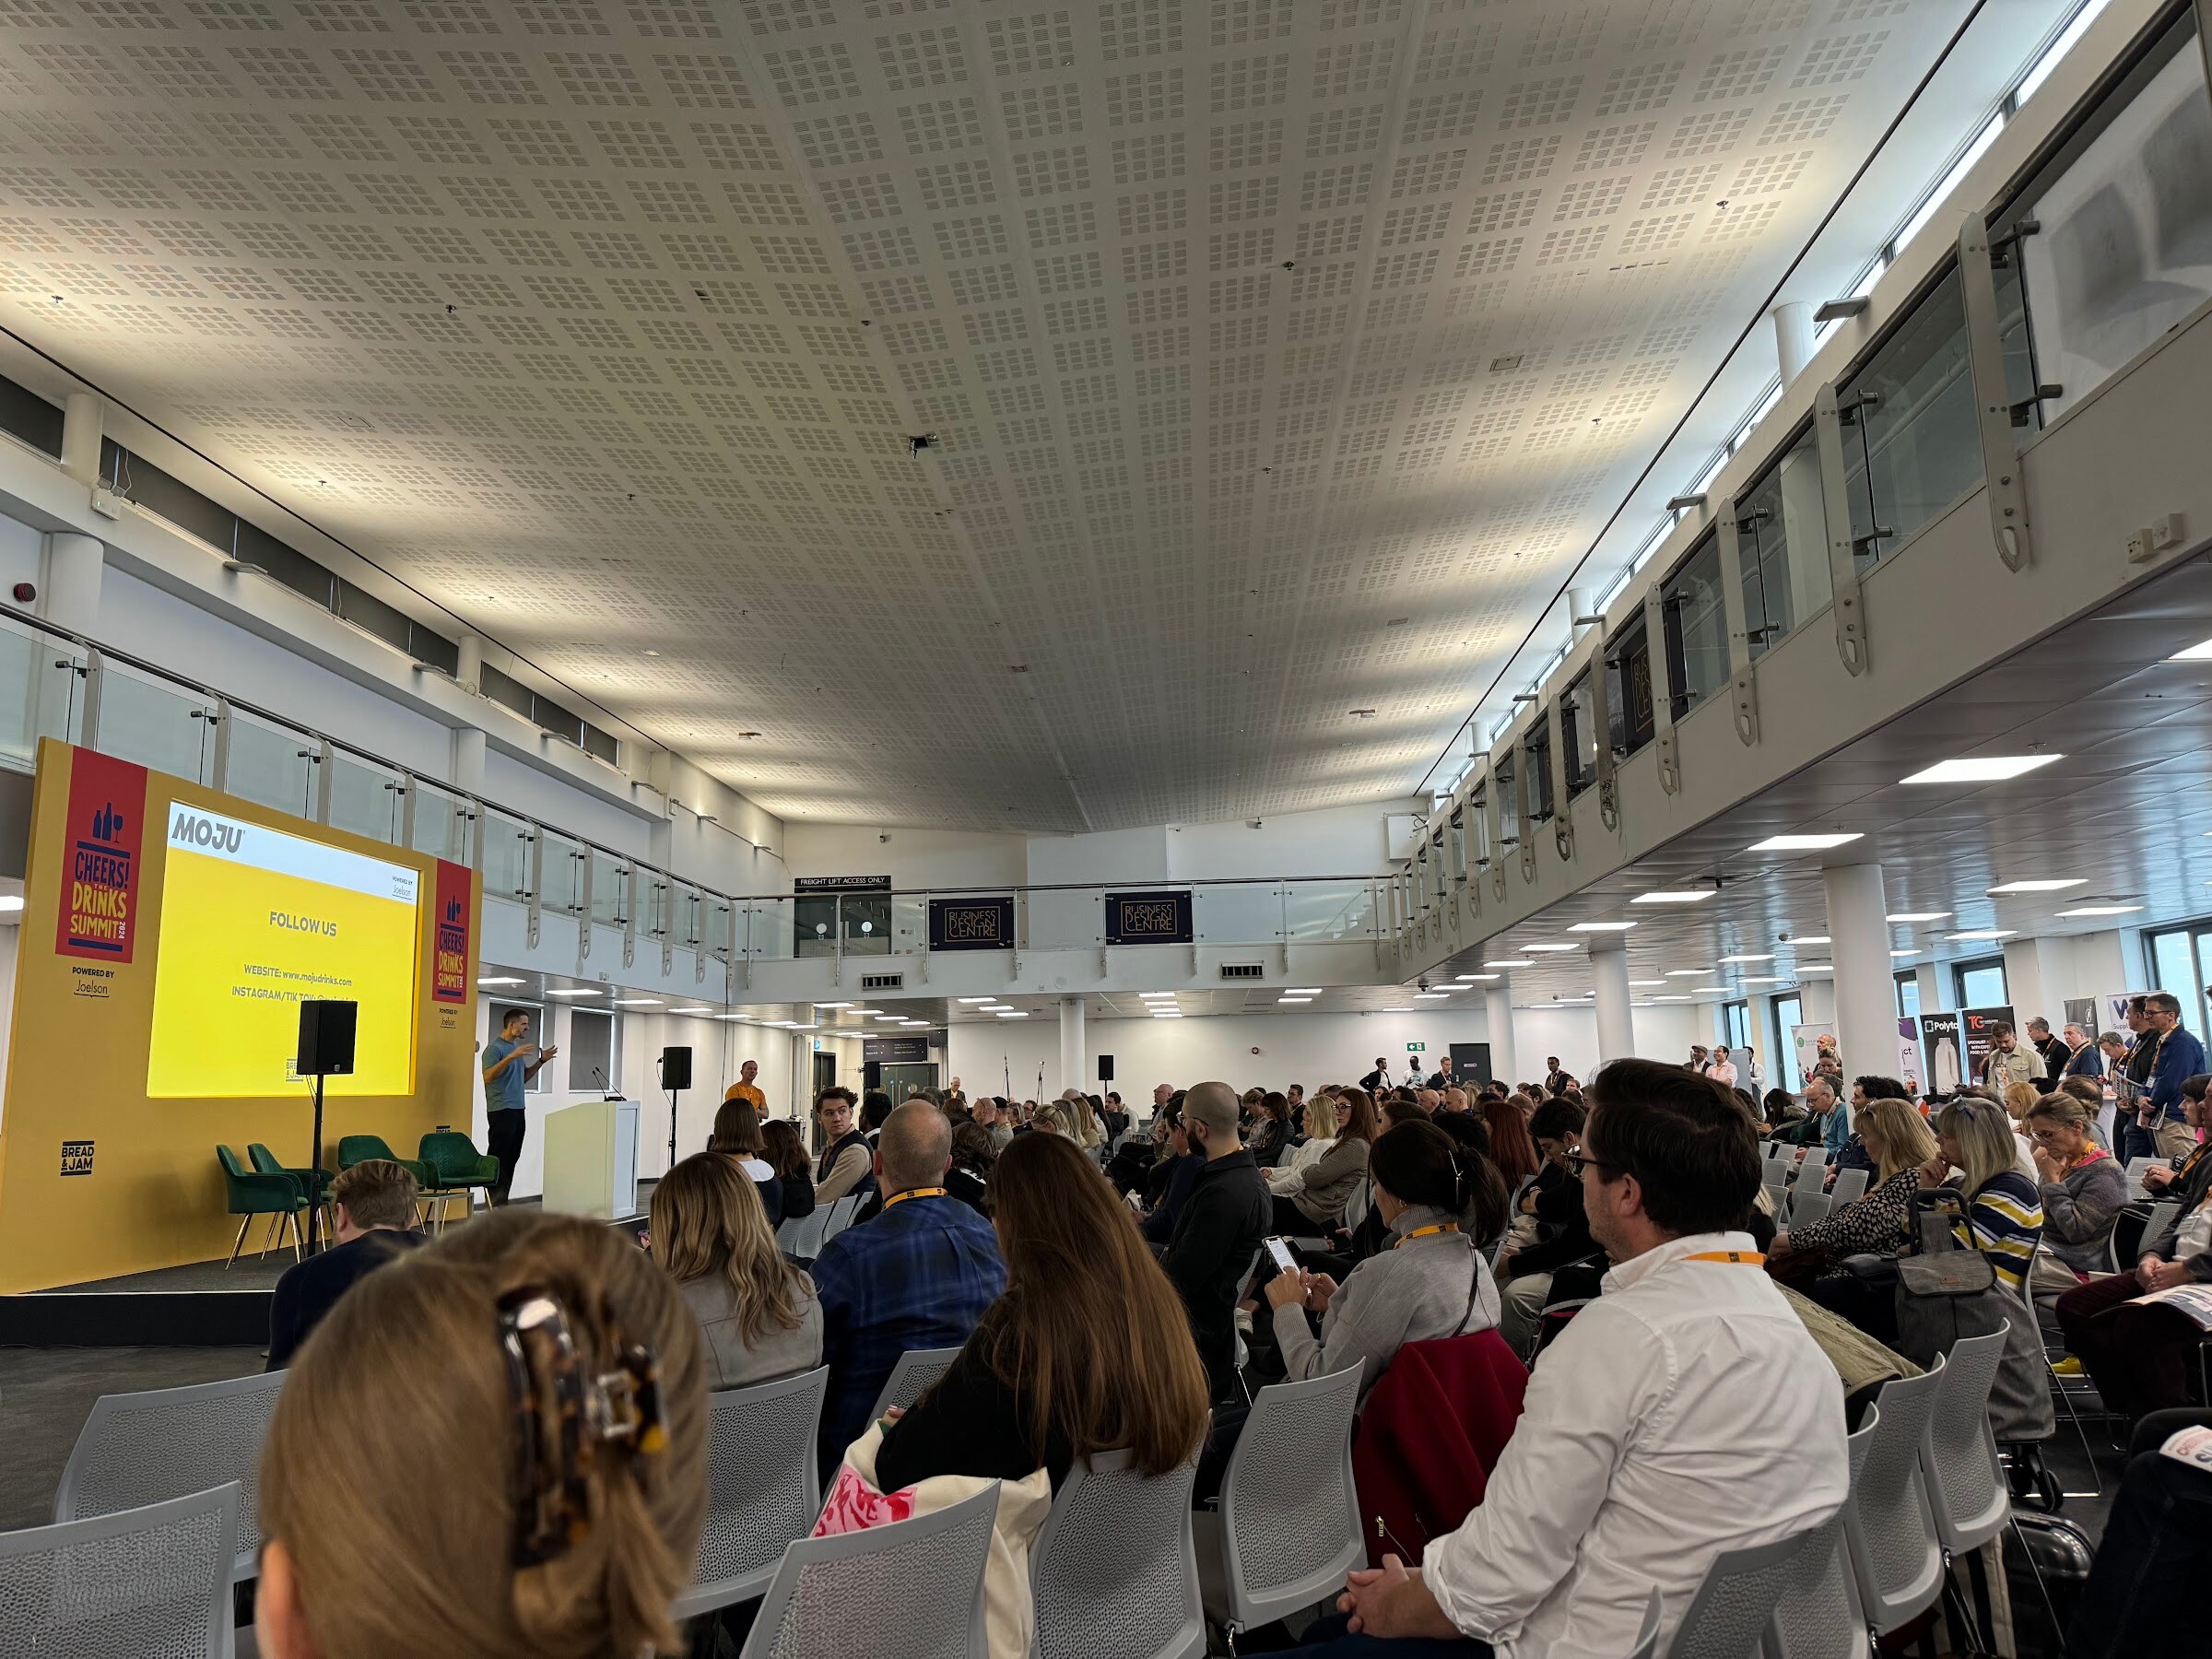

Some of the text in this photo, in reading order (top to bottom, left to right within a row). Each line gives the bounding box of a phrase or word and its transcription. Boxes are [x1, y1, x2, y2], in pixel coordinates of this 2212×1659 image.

[171, 813, 242, 853] MOJU
[75, 852, 130, 889] CHEERS!
[94, 883, 108, 891] THE
[72, 881, 127, 919] DRINKS
[948, 911, 996, 920] BUSINESS
[1125, 904, 1172, 913] BUSINESS
[269, 911, 337, 937] FOLLOW US
[949, 918, 995, 929] DESIGN
[1125, 912, 1172, 923] DESIGN
[1125, 919, 1172, 932] CENTRE
[70, 913, 119, 940] SUMMIT
[118, 921, 126, 940] 2024
[948, 924, 996, 938] CENTRE
[439, 930, 465, 954] CHEERS!
[438, 950, 464, 974] DRINKS
[72, 966, 114, 979] POWERED BY
[243, 963, 352, 987] WEBSITE: www.mojudrinks.com
[438, 972, 460, 988] SUMMIT
[76, 980, 108, 994] Joelson
[231, 985, 298, 1002] INSTAGRAM/TIK
[62, 1146, 95, 1158] BREAD
